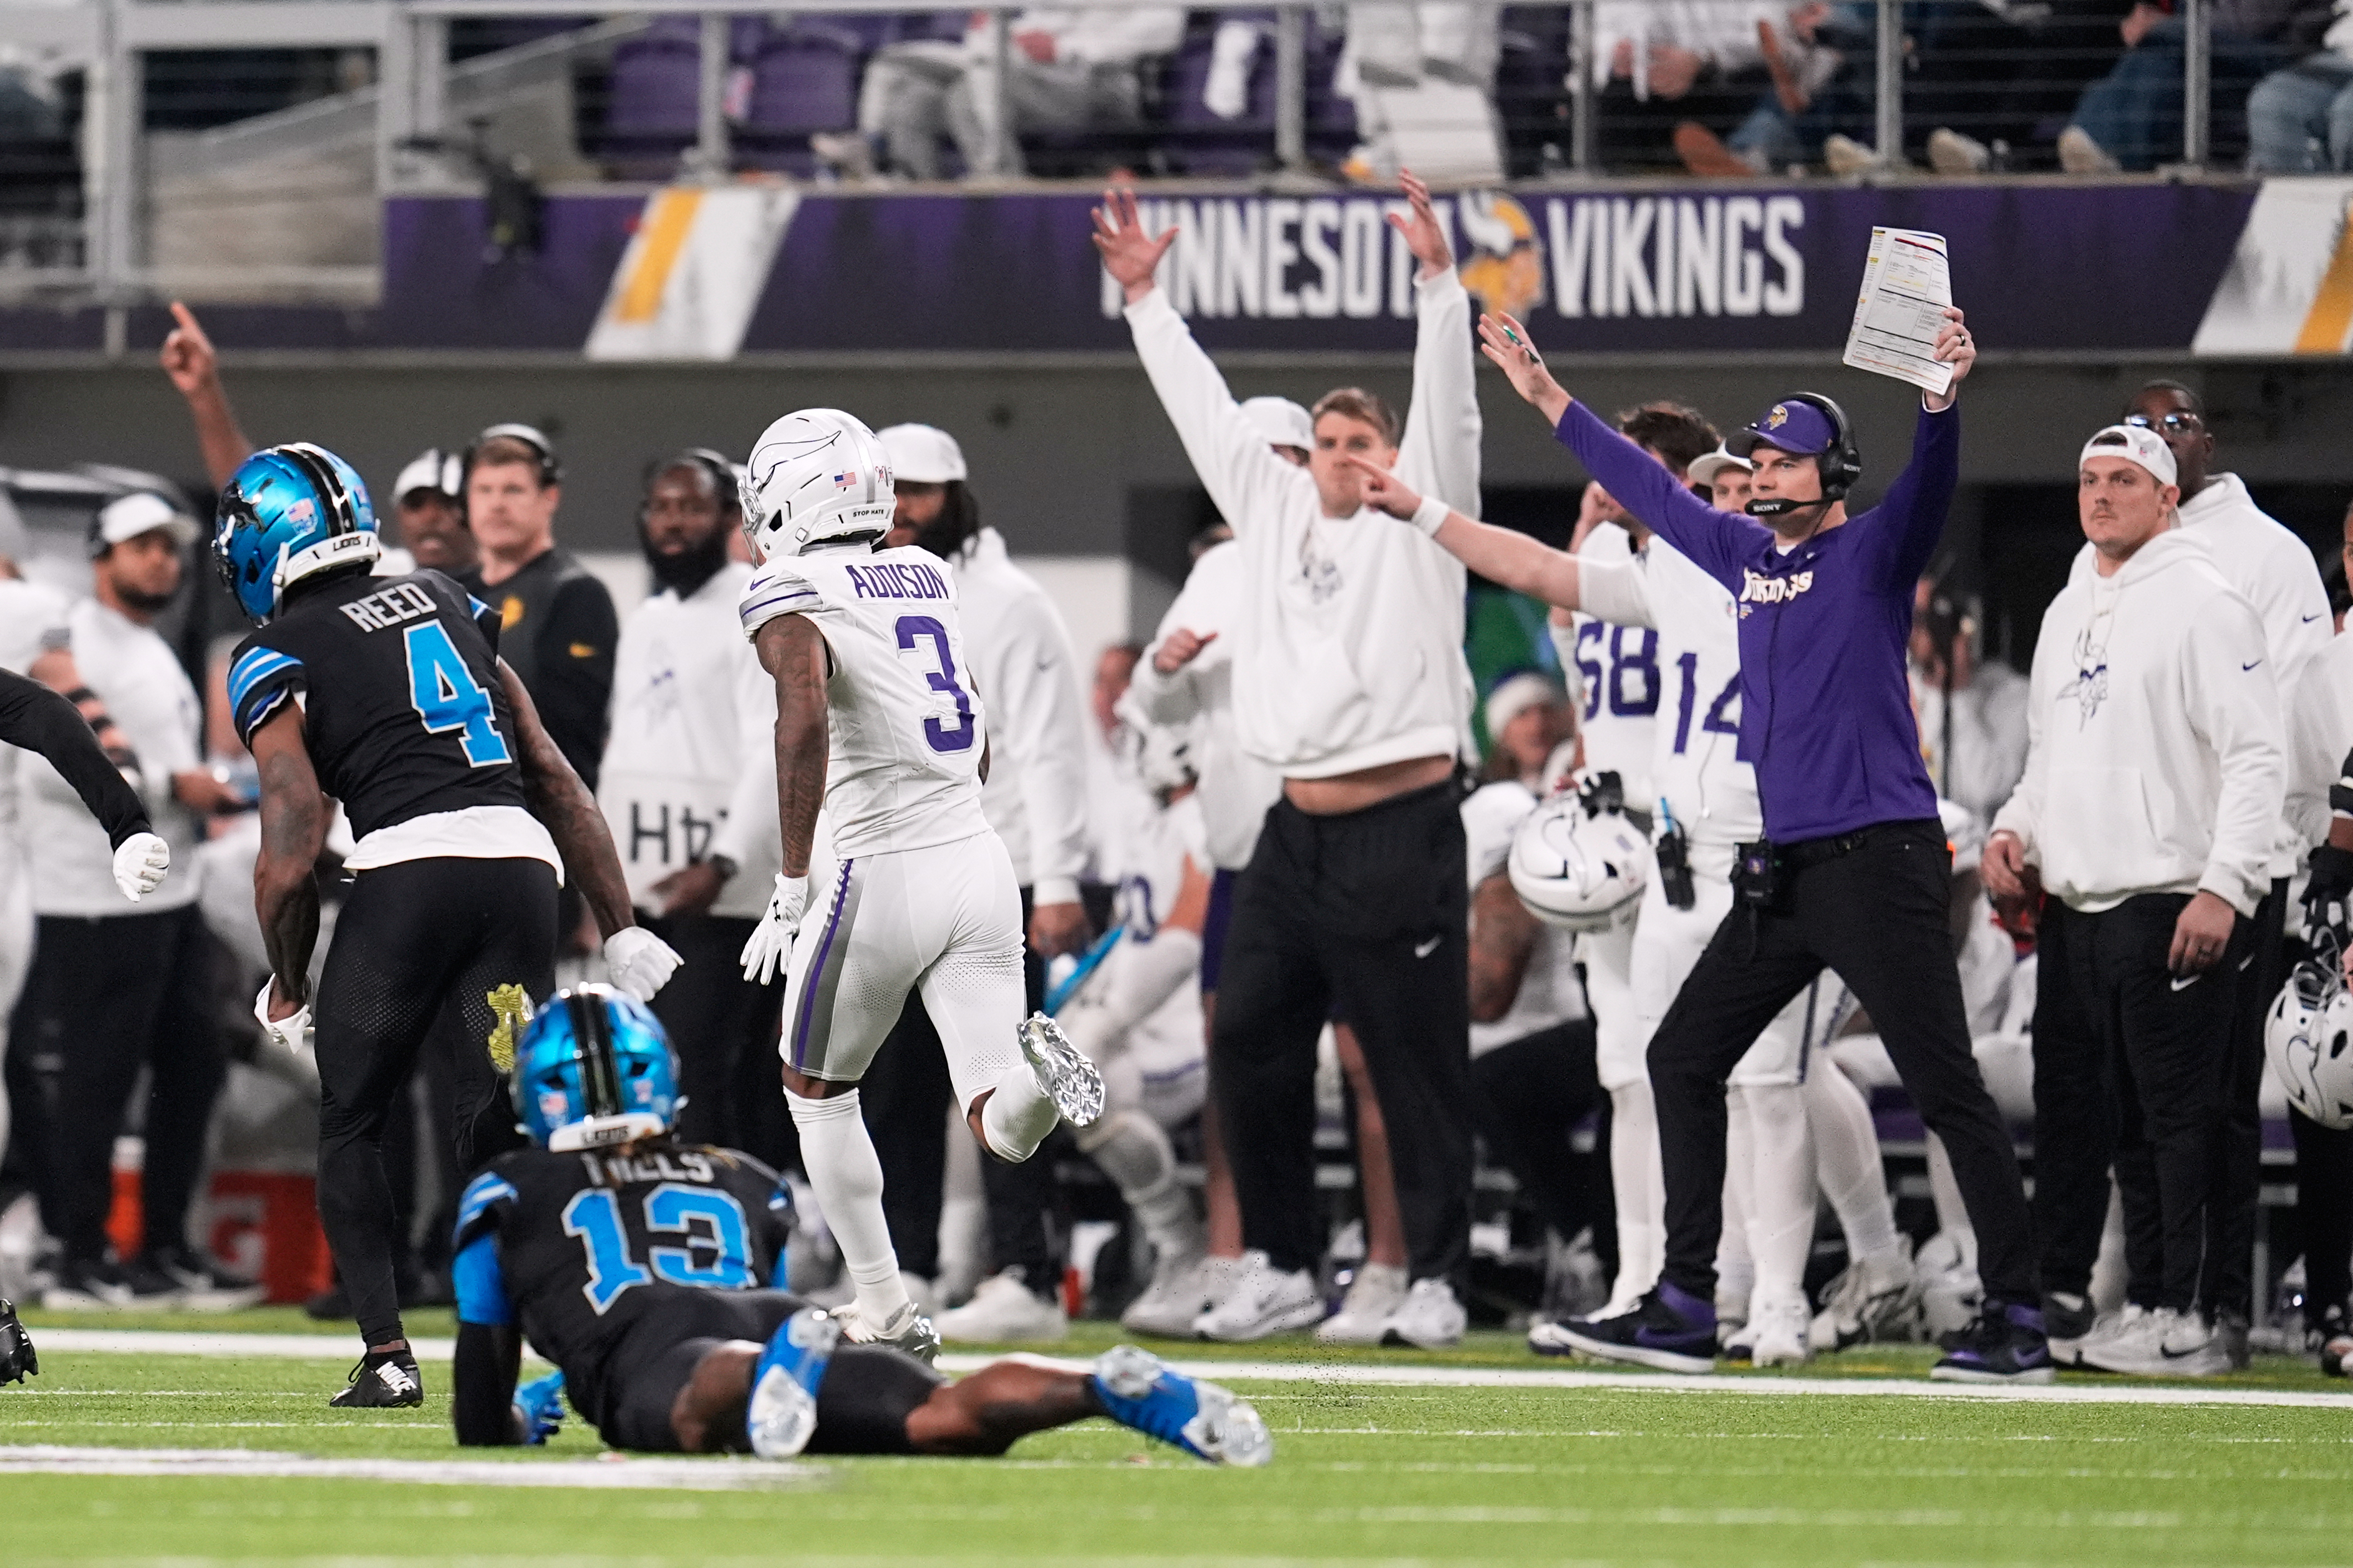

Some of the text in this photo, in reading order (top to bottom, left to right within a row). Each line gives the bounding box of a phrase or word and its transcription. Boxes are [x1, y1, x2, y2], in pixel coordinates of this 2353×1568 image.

[1101, 198, 1457, 318] INNESOT
[1546, 196, 1805, 318] VIKINGS
[1753, 503, 1781, 512] SONY
[339, 583, 437, 632] REED
[845, 563, 949, 599] ADDISON
[403, 618, 513, 768] 4
[893, 613, 975, 755] 3
[561, 1181, 757, 1316] 13
[376, 1360, 417, 1396] NIKE
